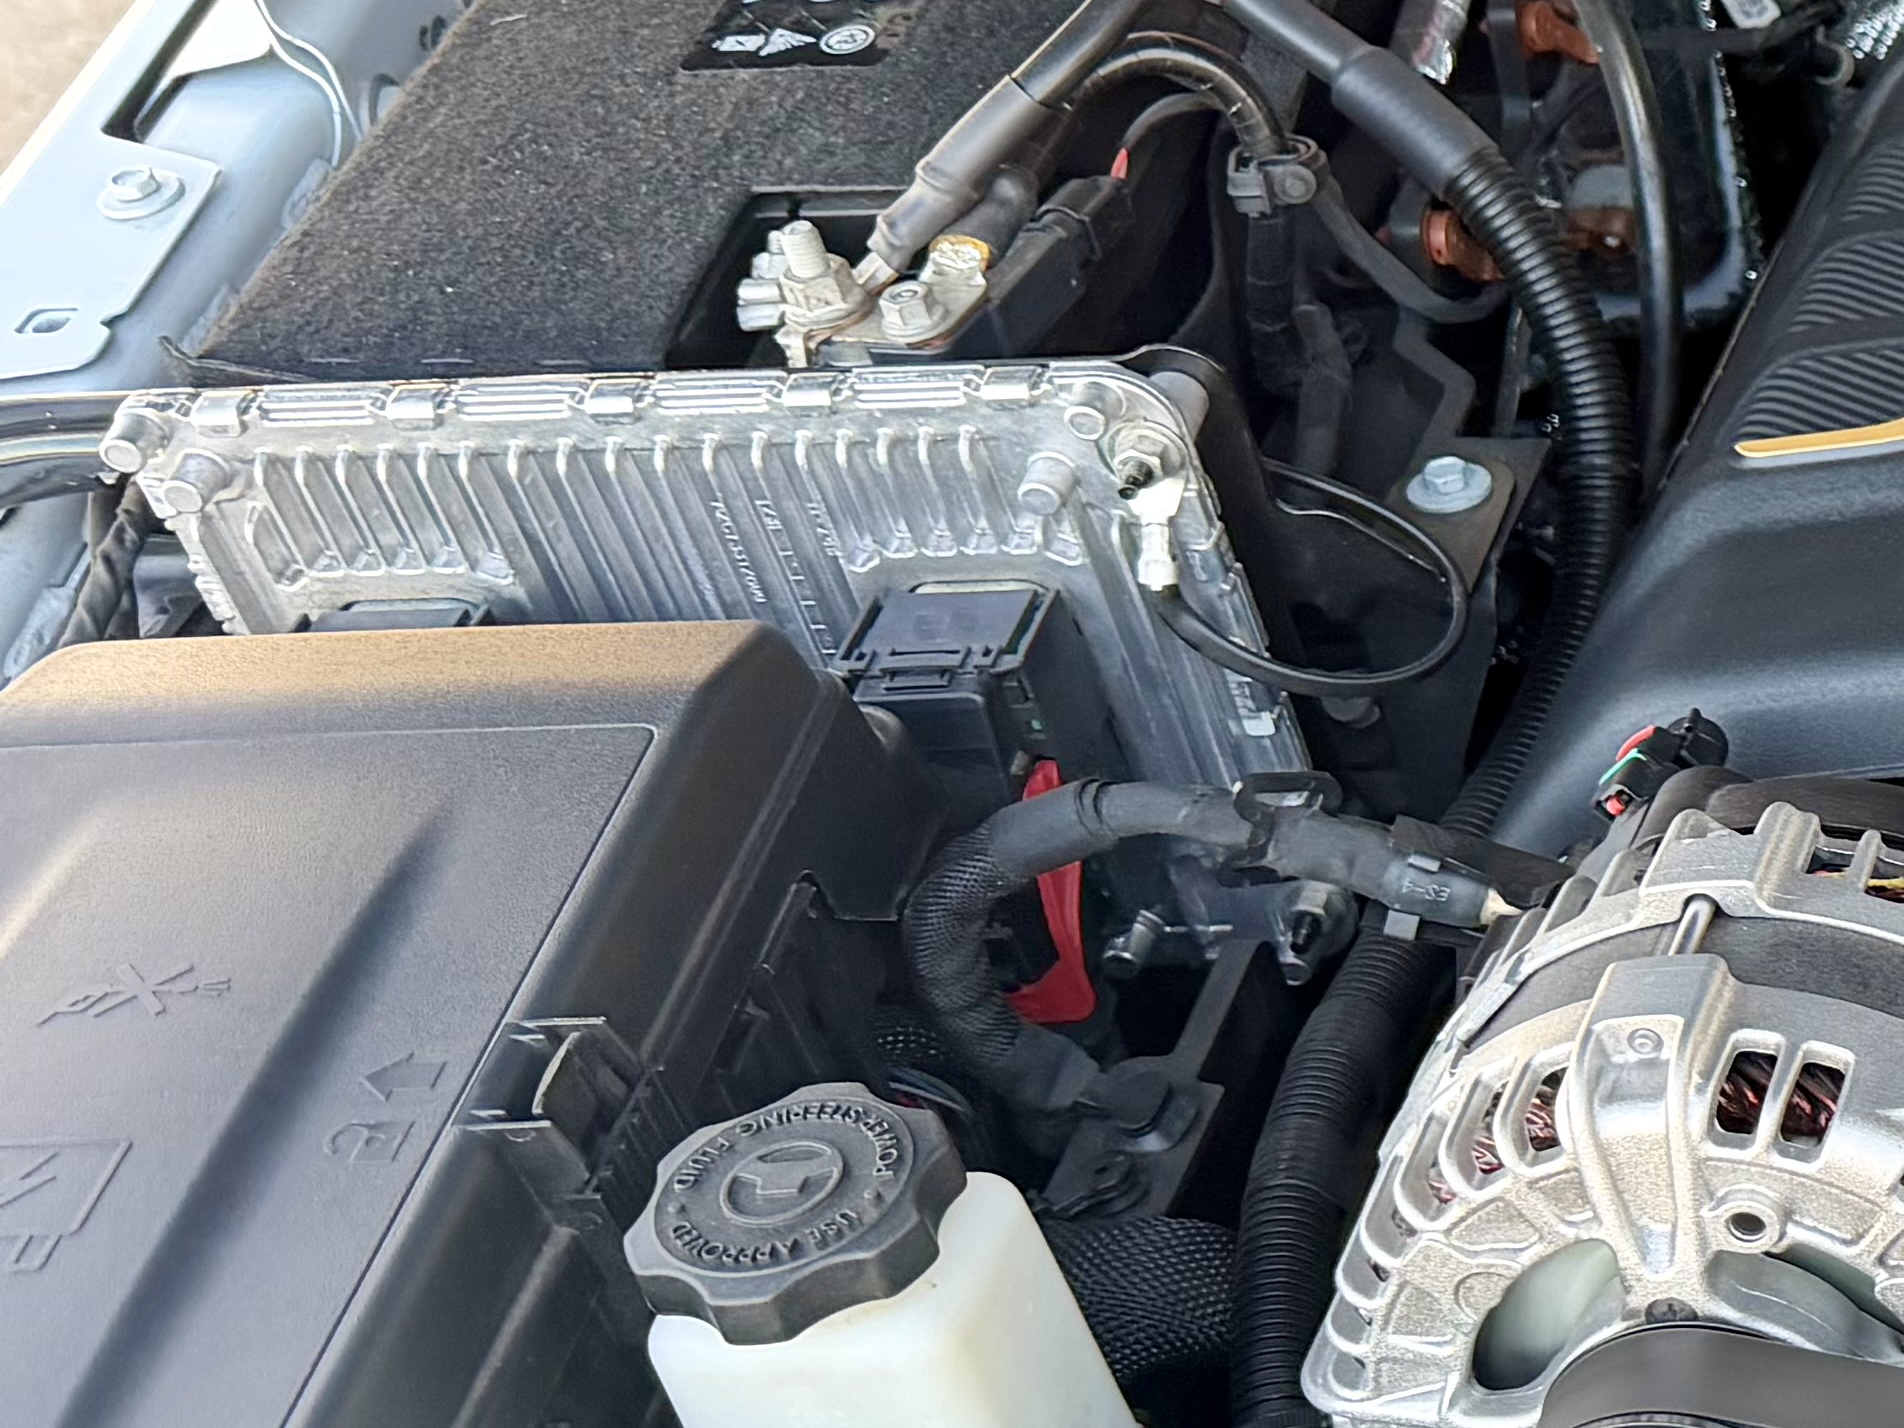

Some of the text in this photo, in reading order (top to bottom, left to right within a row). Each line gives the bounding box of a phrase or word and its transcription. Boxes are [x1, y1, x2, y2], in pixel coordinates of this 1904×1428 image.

[673, 1137, 733, 1192] FLUID
[860, 1115, 899, 1180] POWER
[671, 1209, 858, 1264] USE APPROVED
